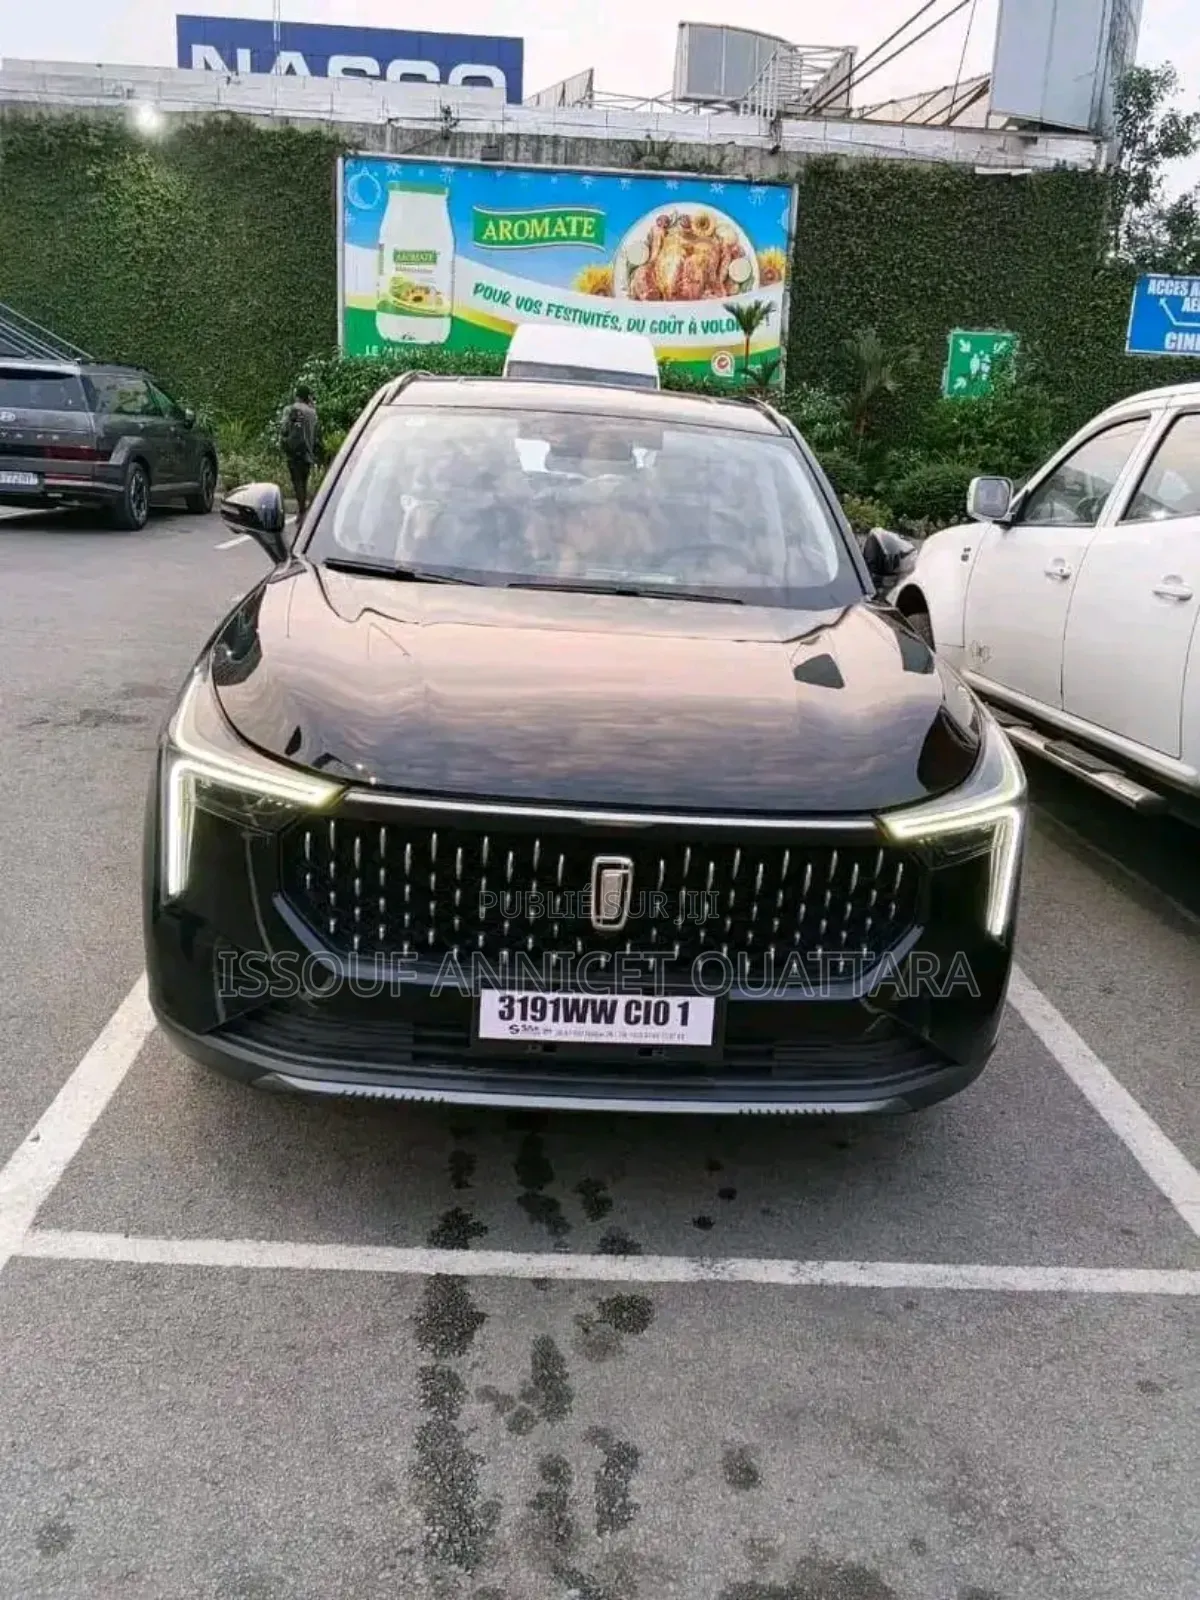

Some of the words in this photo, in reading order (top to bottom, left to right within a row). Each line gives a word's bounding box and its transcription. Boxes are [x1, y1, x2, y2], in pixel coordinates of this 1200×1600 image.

[482, 214, 597, 242] AROMATE
[473, 281, 512, 307] POUR
[515, 295, 543, 315] VOS
[545, 302, 622, 333] FESTIVITÉS,
[627, 317, 646, 333] DU
[650, 314, 685, 335] GOÛT
[688, 316, 698, 335] À
[701, 317, 743, 335] VOLO
[498, 995, 618, 1025] 3191WW
